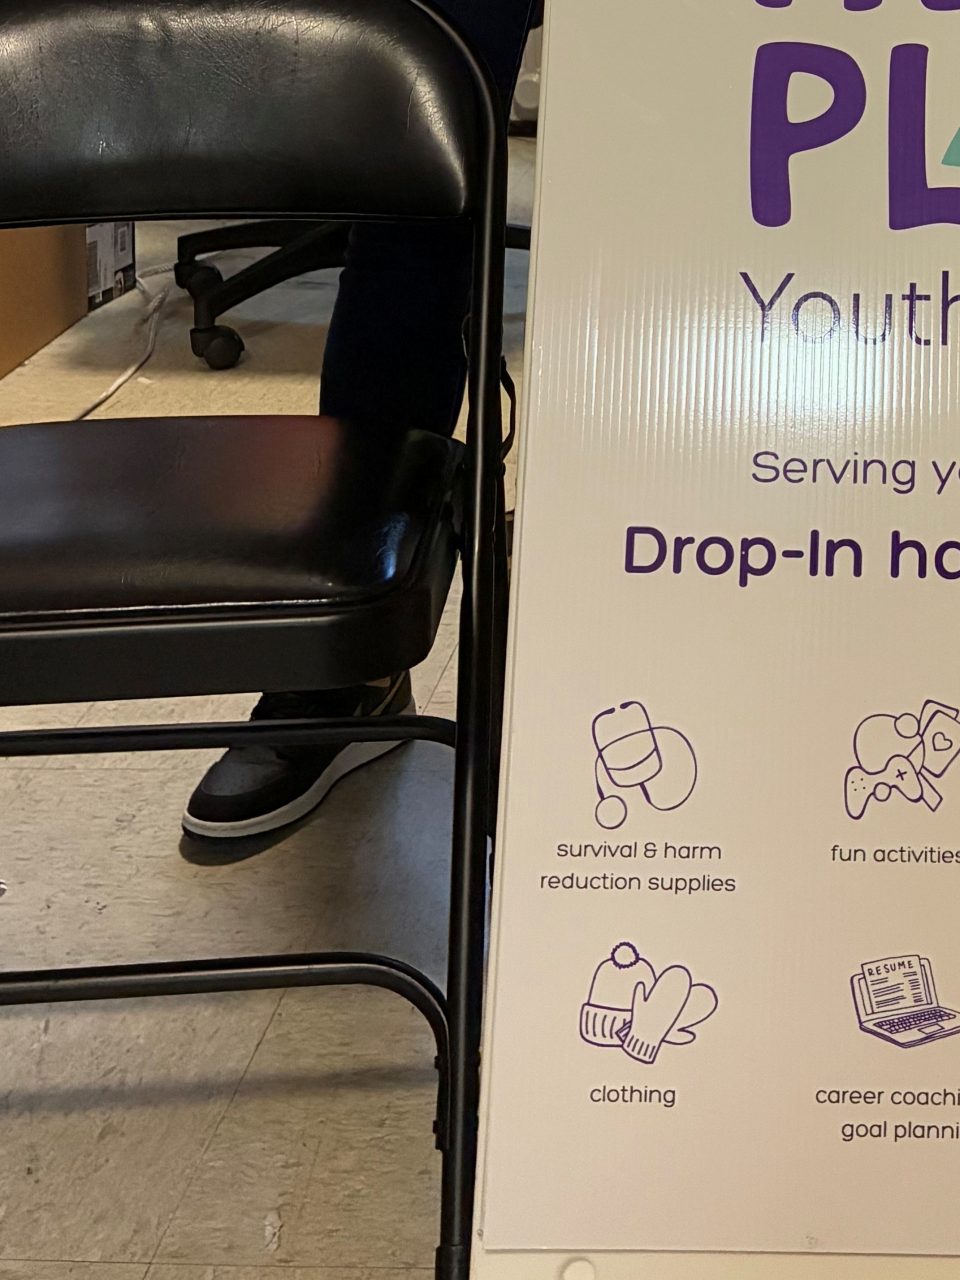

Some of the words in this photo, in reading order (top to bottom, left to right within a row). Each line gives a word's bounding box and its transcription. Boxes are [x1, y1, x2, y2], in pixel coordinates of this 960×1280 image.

[751, 450, 916, 495] Serving
[624, 526, 863, 588] Drop-In
[556, 841, 638, 859] survival
[643, 841, 658, 859] &
[663, 842, 722, 860] harm
[831, 844, 866, 862] fun
[540, 872, 641, 890] reduction
[647, 874, 736, 895] supplies
[867, 959, 914, 977] RESUME
[589, 1085, 676, 1108] clothing
[815, 1089, 885, 1105] career
[841, 1120, 887, 1142] goal
